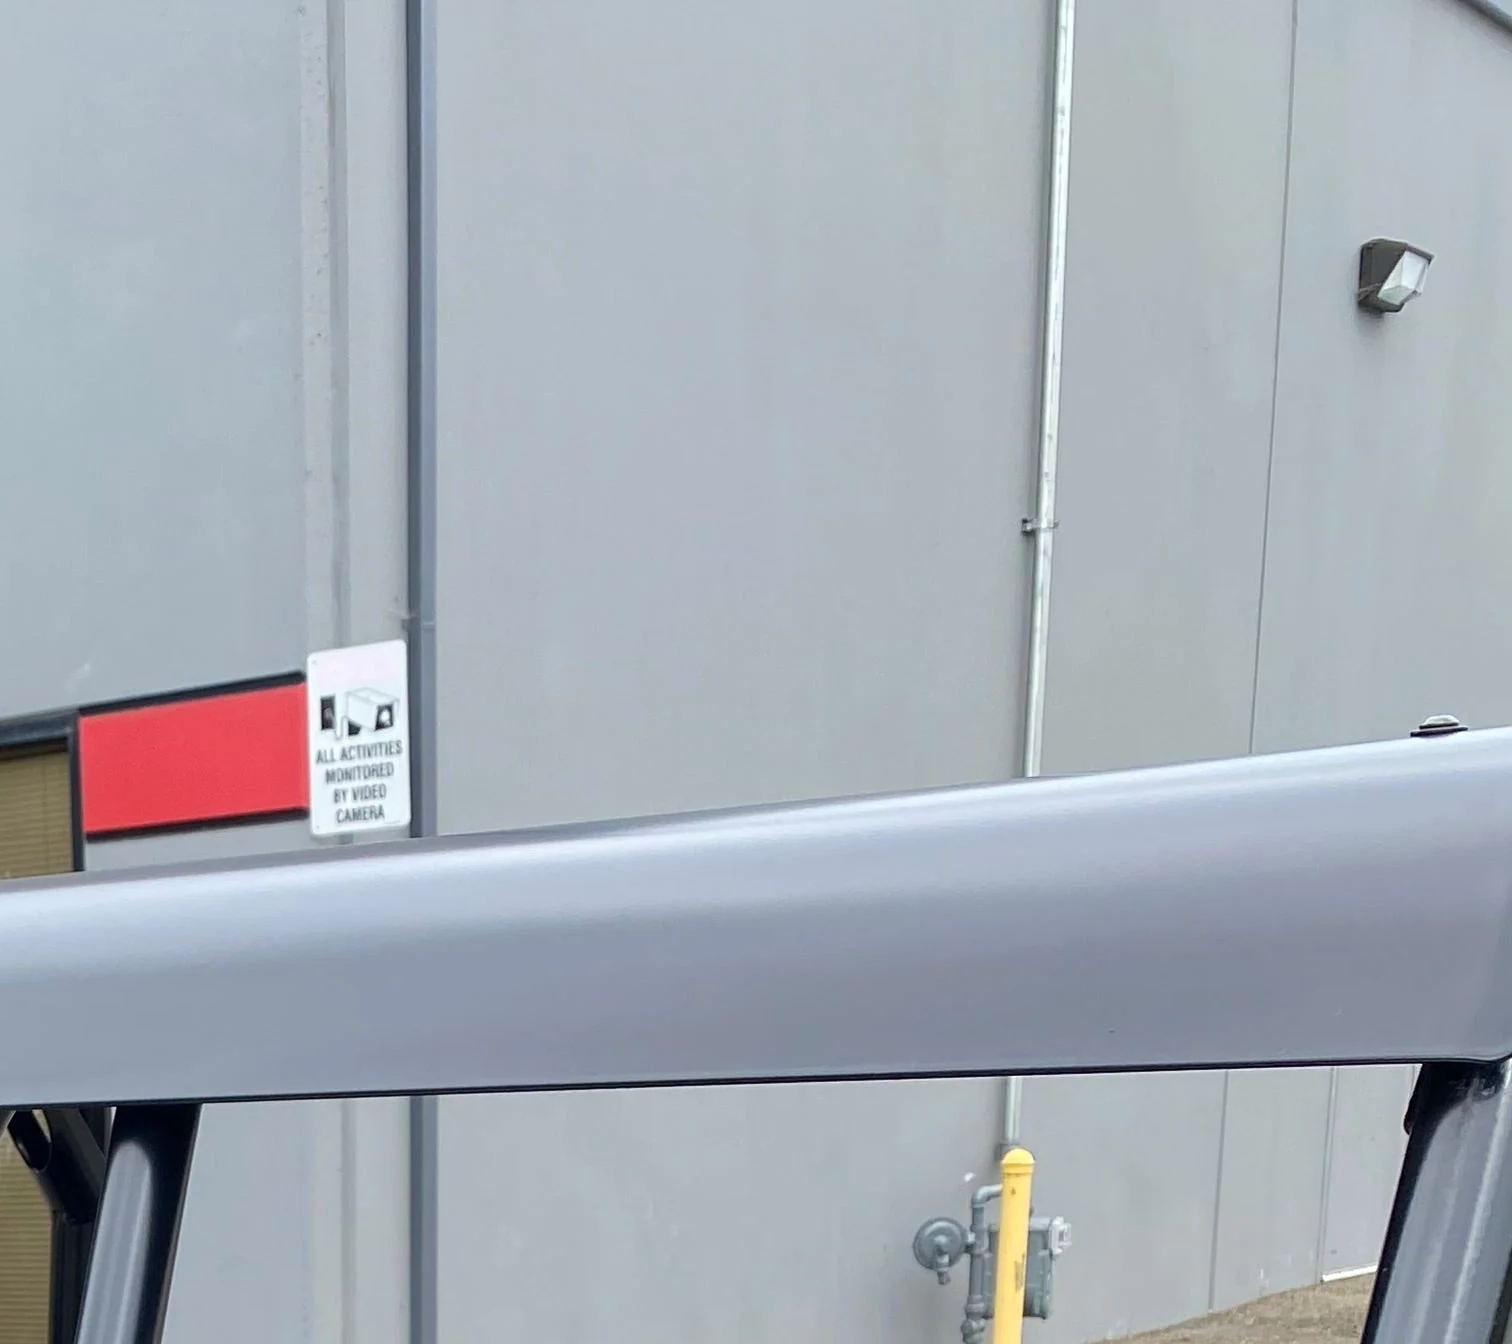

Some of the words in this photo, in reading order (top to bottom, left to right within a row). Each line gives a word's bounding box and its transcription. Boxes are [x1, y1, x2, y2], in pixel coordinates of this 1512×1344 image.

[316, 748, 336, 764] ALL
[340, 740, 403, 761] ACTIVITIES
[325, 762, 395, 785] MONITORED
[333, 786, 348, 804] BY
[352, 783, 387, 802] VIDEO
[336, 804, 385, 824] CAMERA
